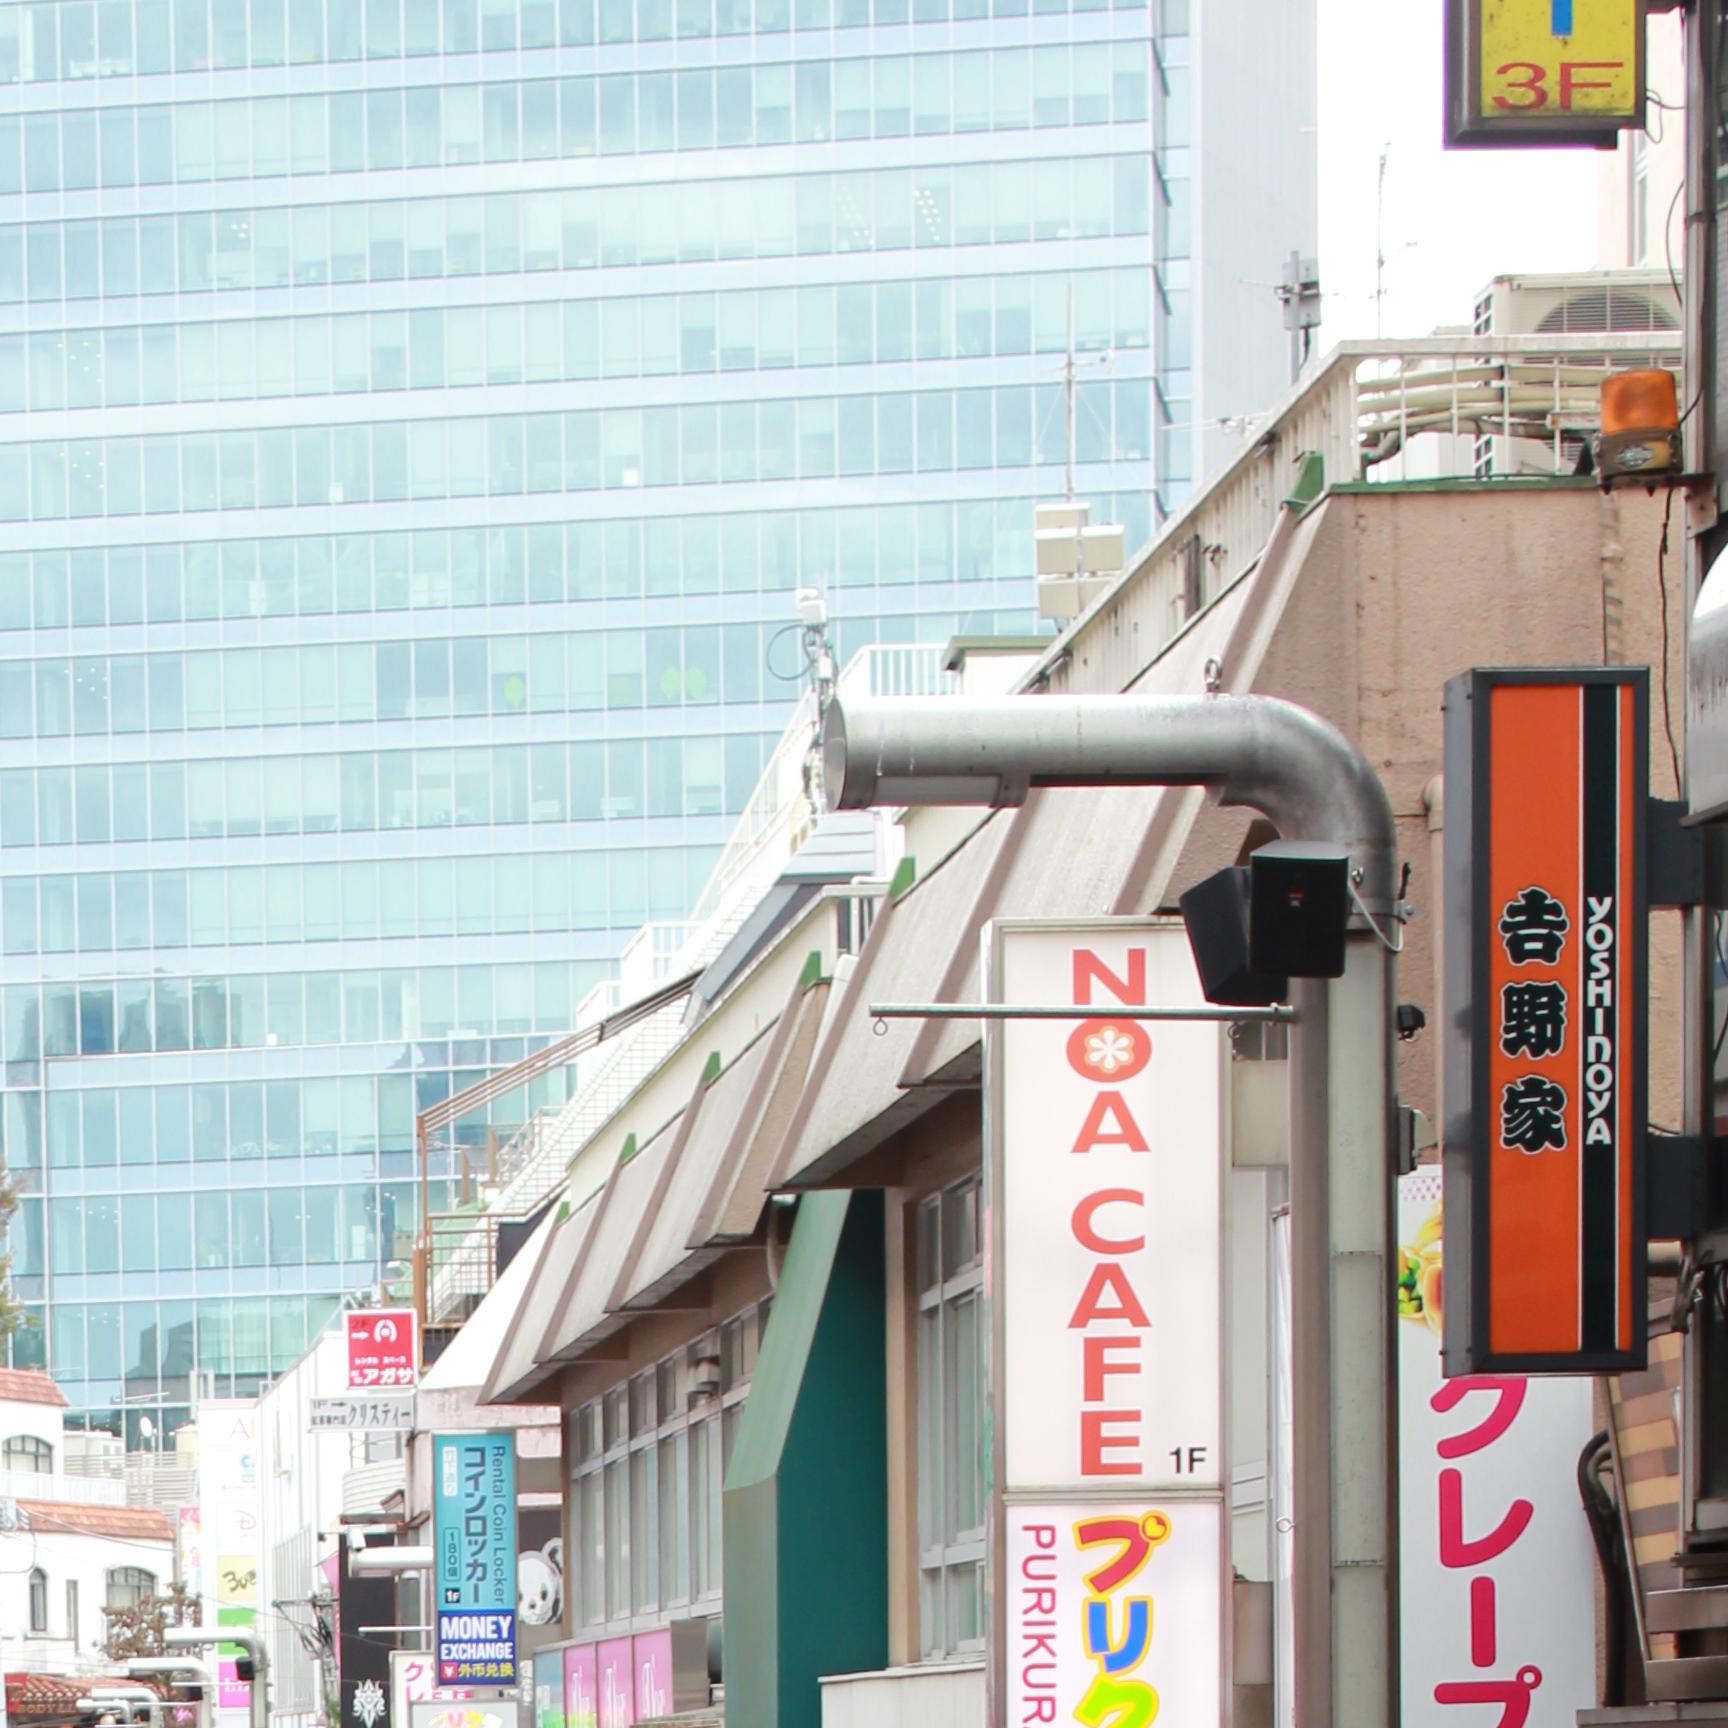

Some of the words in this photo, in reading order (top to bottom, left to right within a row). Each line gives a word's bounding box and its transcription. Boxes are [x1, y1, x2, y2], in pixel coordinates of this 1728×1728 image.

[1492, 61, 1625, 111] 3F
[1498, 887, 1572, 1154] 吉野家
[1585, 895, 1613, 1147] YOSHINOYA
[1066, 947, 1154, 1154] NOA
[1066, 1186, 1154, 1478] CAFE
[362, 1366, 413, 1384] アガサ
[348, 1402, 411, 1426] クリスティー
[491, 1445, 506, 1499] Rental
[1170, 1446, 1208, 1474] 1F
[464, 1446, 487, 1604] コインロッカー
[491, 1503, 507, 1542] Coin
[445, 1589, 460, 1603] 1F
[492, 1547, 508, 1604] Locker
[440, 1615, 513, 1640] MONEY
[440, 1642, 514, 1660] EXCHANGE
